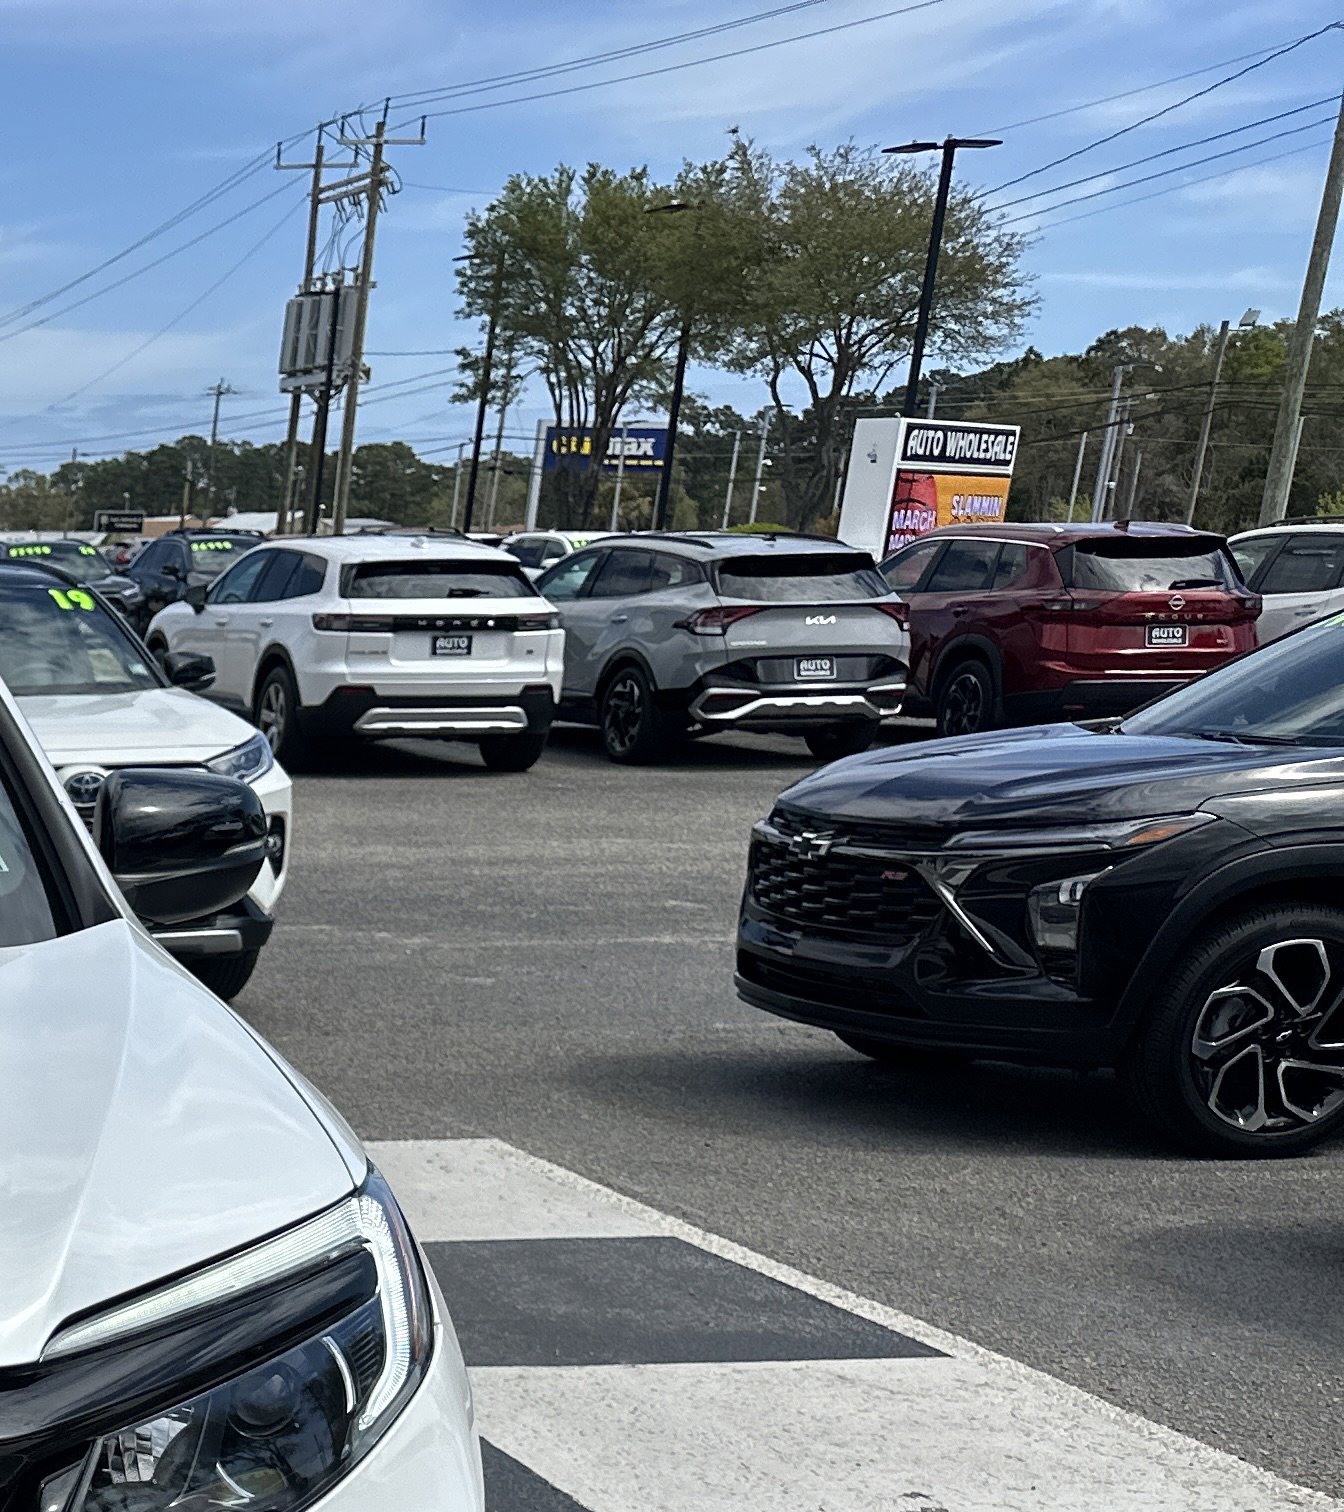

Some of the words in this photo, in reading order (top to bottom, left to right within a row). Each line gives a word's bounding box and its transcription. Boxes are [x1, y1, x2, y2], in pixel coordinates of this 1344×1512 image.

[907, 429, 944, 456] AUTO
[946, 431, 1015, 461] WHOLESALE
[892, 509, 937, 532] MARCH
[48, 589, 96, 611] 19
[1152, 627, 1183, 638] AUTO
[436, 637, 468, 648] AUTO
[800, 659, 830, 671] AUTO
